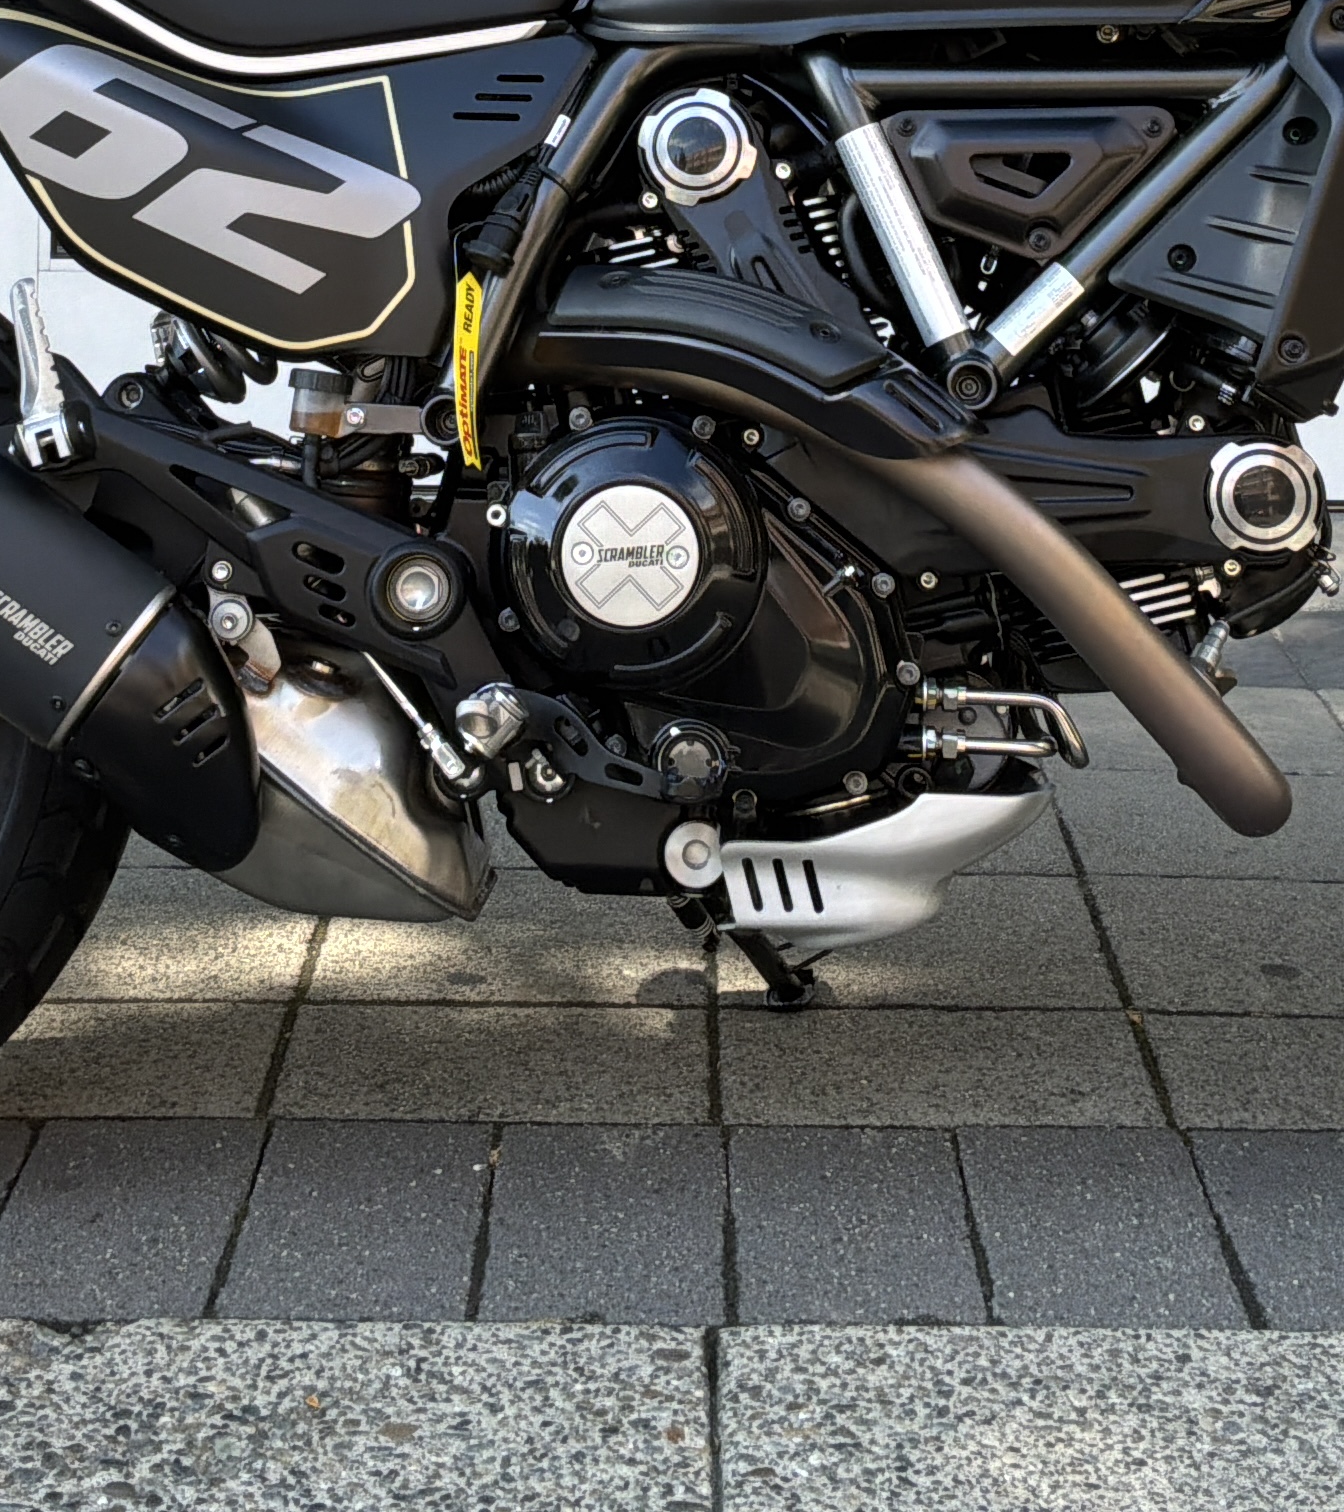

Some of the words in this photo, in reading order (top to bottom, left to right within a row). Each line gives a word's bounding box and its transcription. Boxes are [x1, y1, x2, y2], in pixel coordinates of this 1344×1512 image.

[462, 282, 476, 334] READY
[596, 544, 665, 564] SCRAMBLER
[627, 558, 664, 569] DUCATI
[12, 629, 59, 666] DUCATI
